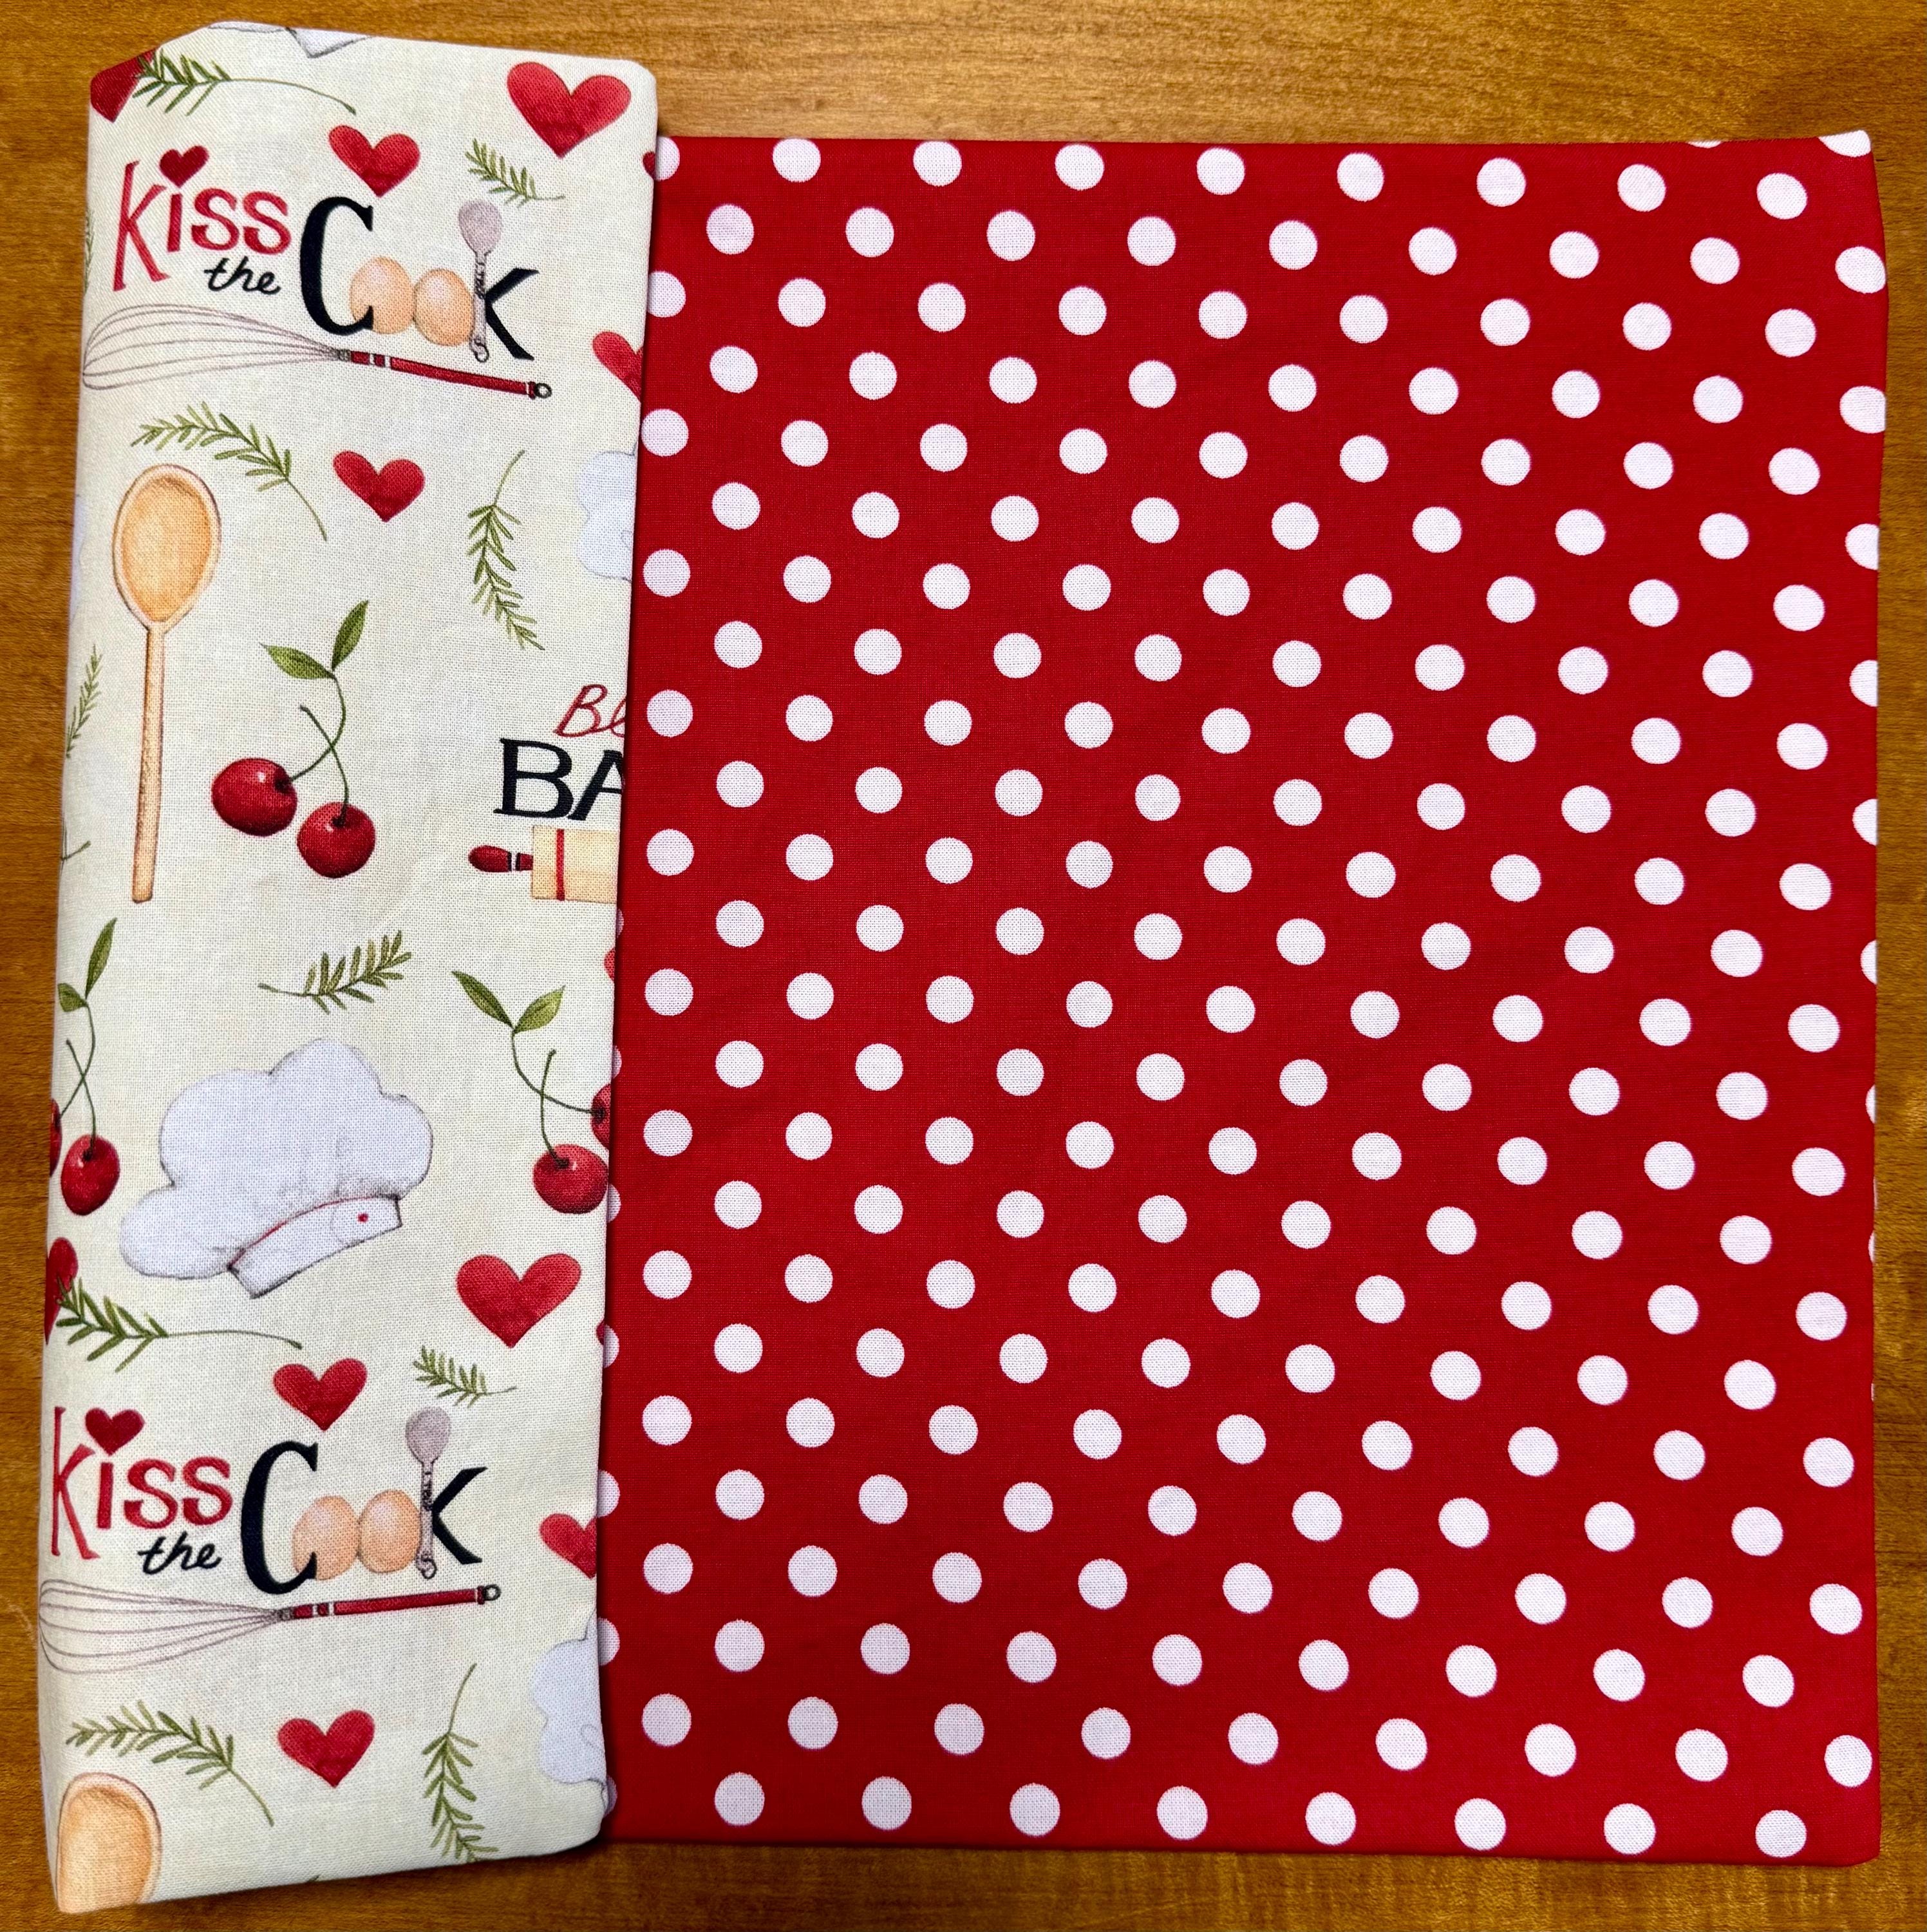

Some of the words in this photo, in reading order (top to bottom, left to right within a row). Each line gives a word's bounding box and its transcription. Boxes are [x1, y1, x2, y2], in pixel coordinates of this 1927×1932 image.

[203, 256, 281, 295] the
[299, 196, 539, 362] Cook
[138, 1531, 222, 1575] the
[240, 1406, 487, 1594] Cook
